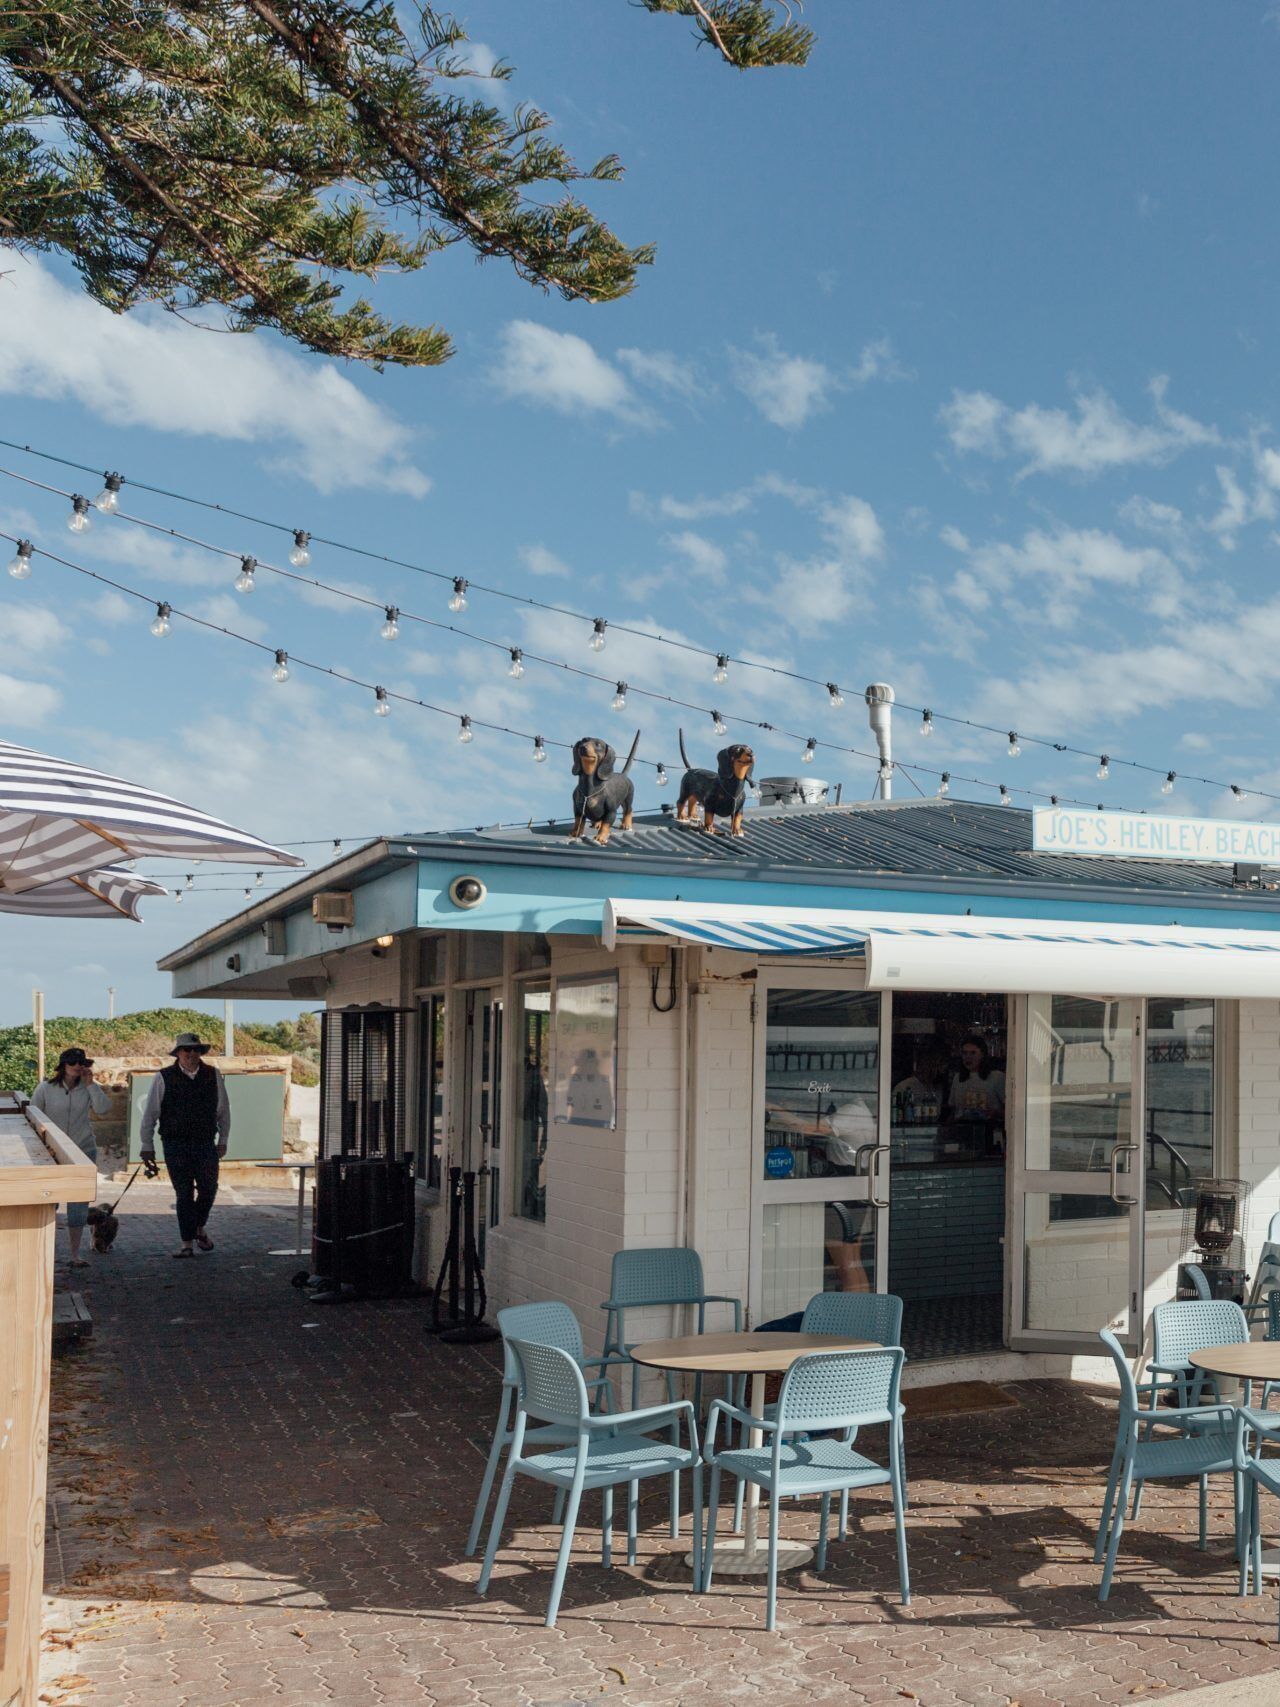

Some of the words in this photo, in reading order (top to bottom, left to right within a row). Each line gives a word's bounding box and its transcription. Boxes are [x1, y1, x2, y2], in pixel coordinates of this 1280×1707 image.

[1043, 815, 1108, 847] JOE'S
[1120, 820, 1205, 852] HENLEY
[808, 1080, 831, 1094] Exit
